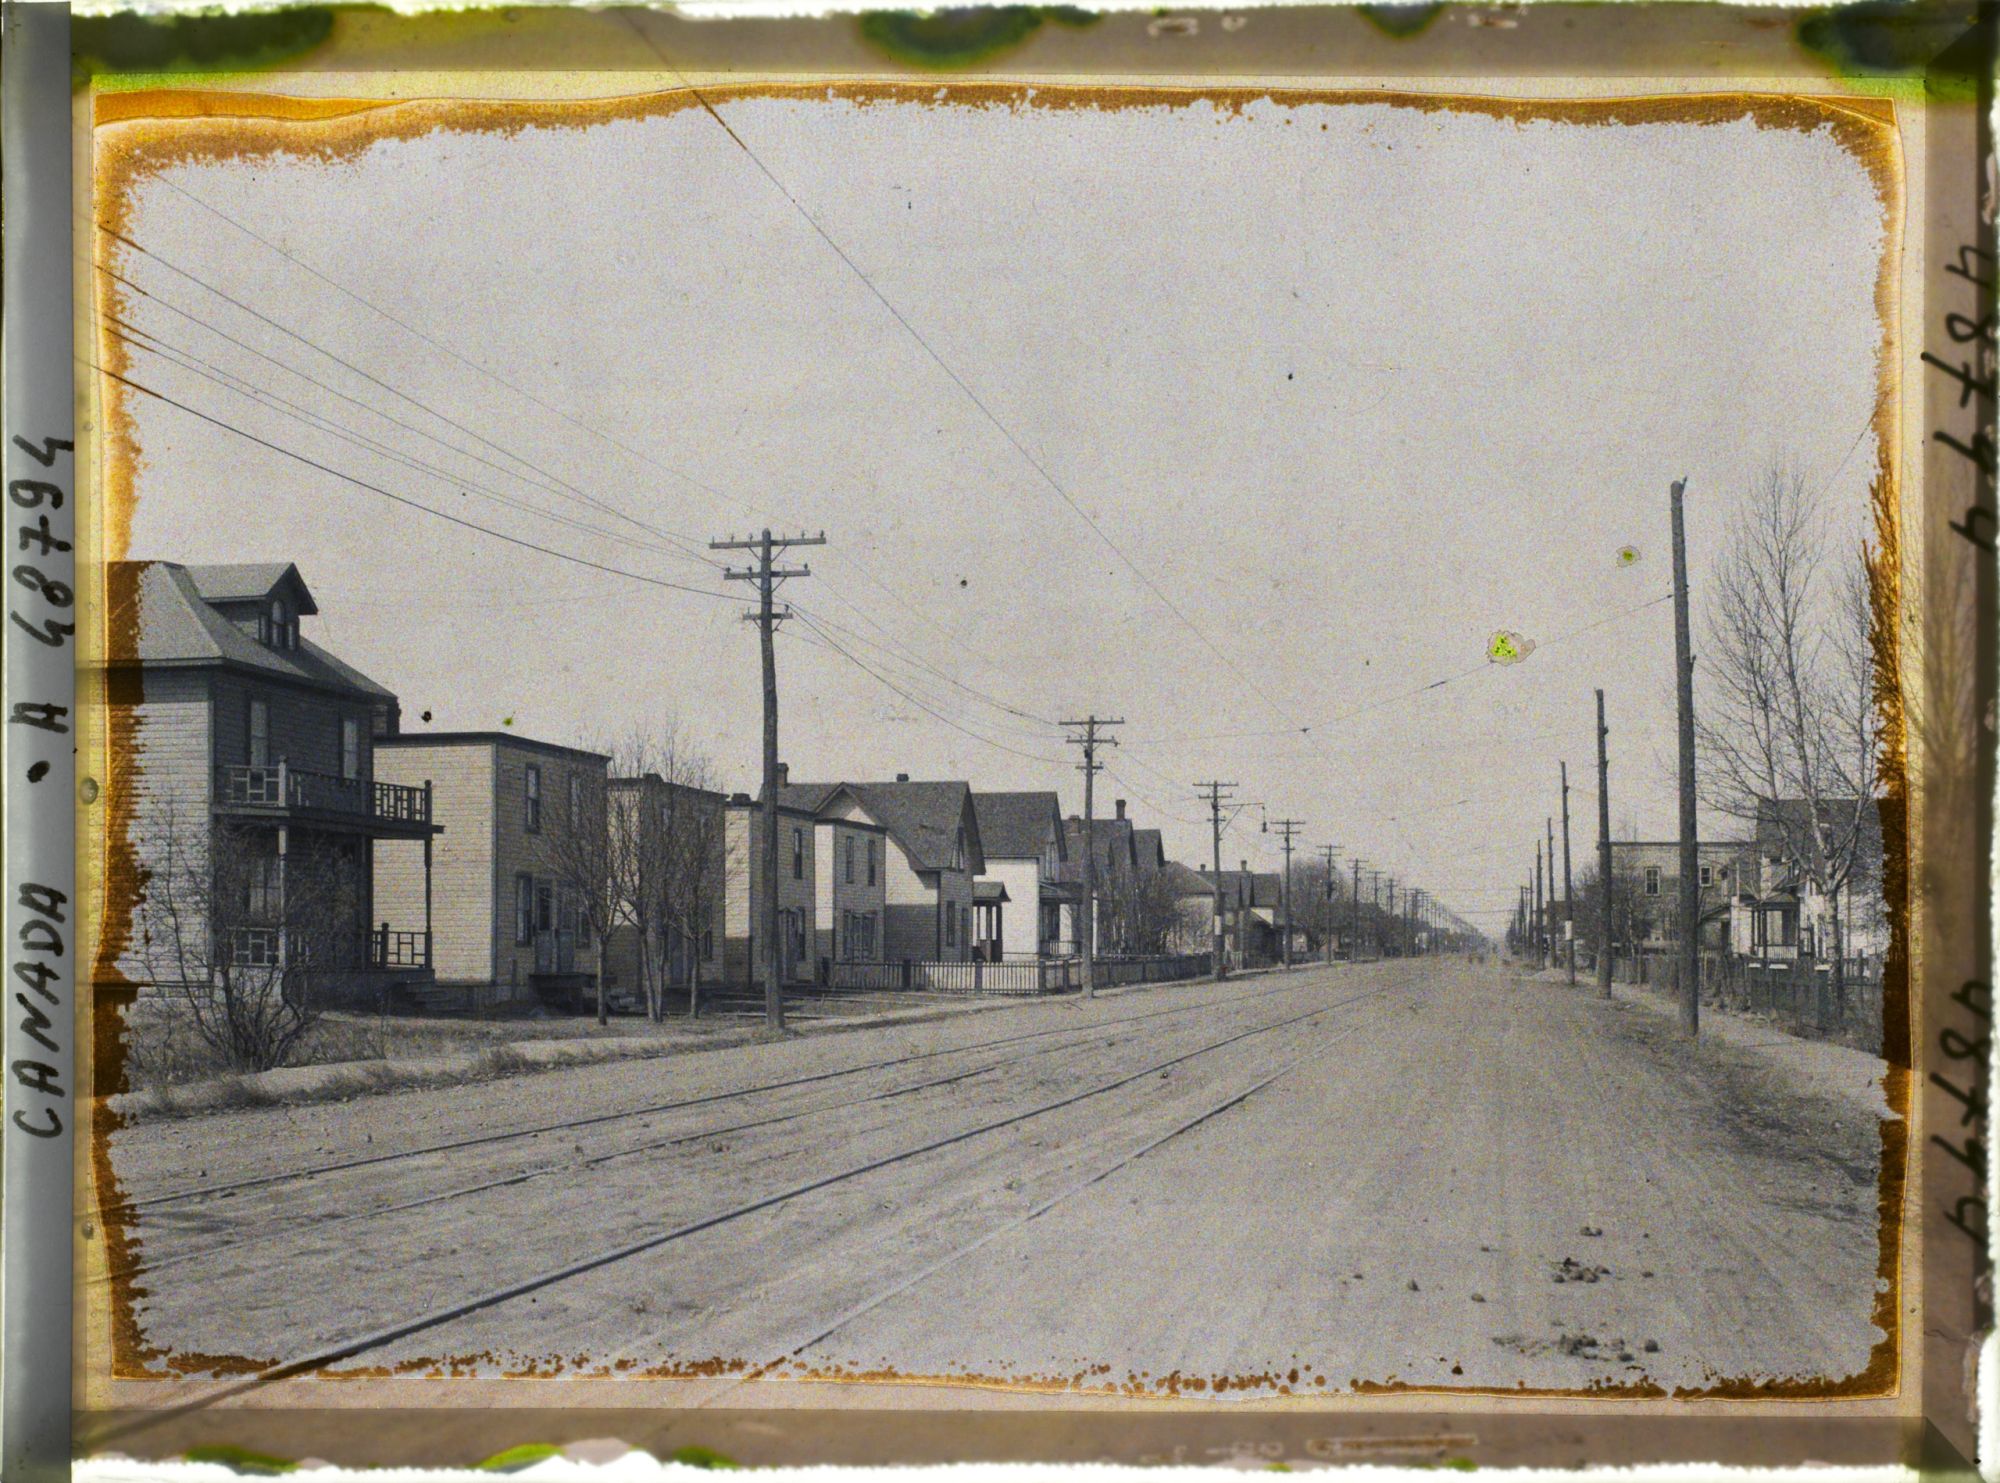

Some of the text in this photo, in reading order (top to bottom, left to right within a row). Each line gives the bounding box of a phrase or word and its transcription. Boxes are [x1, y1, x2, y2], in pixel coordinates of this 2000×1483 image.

[8, 434, 75, 1138] CANADA A 48794
